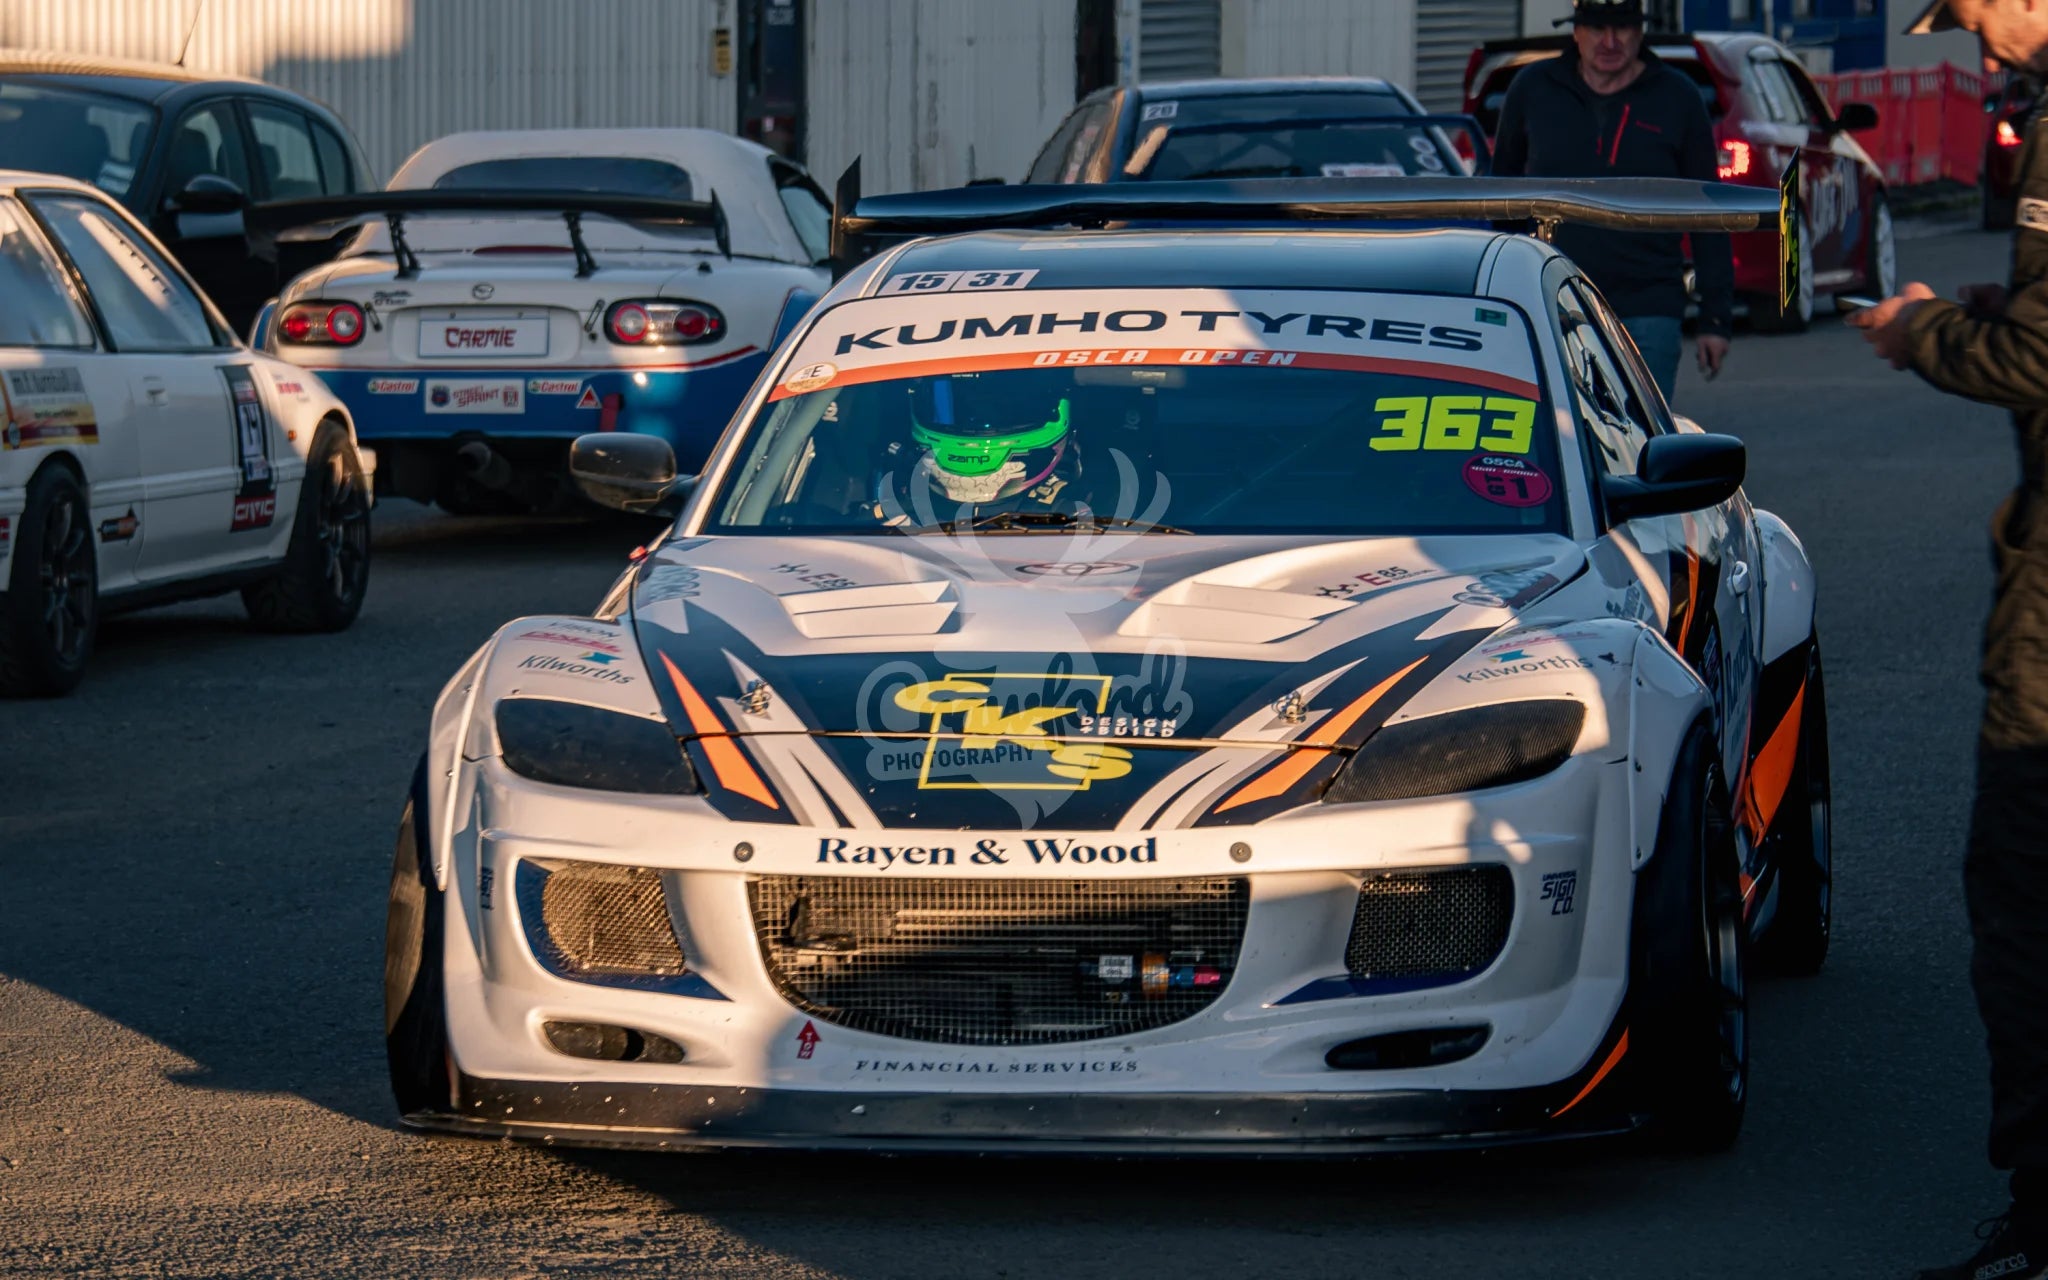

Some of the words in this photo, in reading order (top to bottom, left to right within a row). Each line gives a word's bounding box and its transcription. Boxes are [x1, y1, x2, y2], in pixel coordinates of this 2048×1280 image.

[896, 273, 947, 291] 15
[968, 271, 1022, 289] 31
[1481, 308, 1501, 324] P
[445, 326, 516, 348] CARMIE
[835, 310, 1167, 356] KUMHO
[1180, 310, 1484, 352] TYRES
[1033, 350, 1149, 366] OSCA
[1179, 349, 1297, 366] OPEN
[378, 379, 415, 392] Castrol
[1369, 395, 1537, 453] 363
[947, 453, 991, 465] zamp
[1482, 457, 1525, 468] OSCA
[235, 500, 274, 522] CIVIC
[517, 655, 636, 684] Kilworths
[1457, 657, 1594, 683] Kilworths
[1080, 716, 1177, 729] DESIGN
[817, 837, 957, 870] Rayen
[970, 838, 1009, 865] &
[1023, 836, 1158, 863] Wood
[855, 1059, 999, 1073] FINANCIAL
[1008, 1060, 1138, 1073] SERVICES
